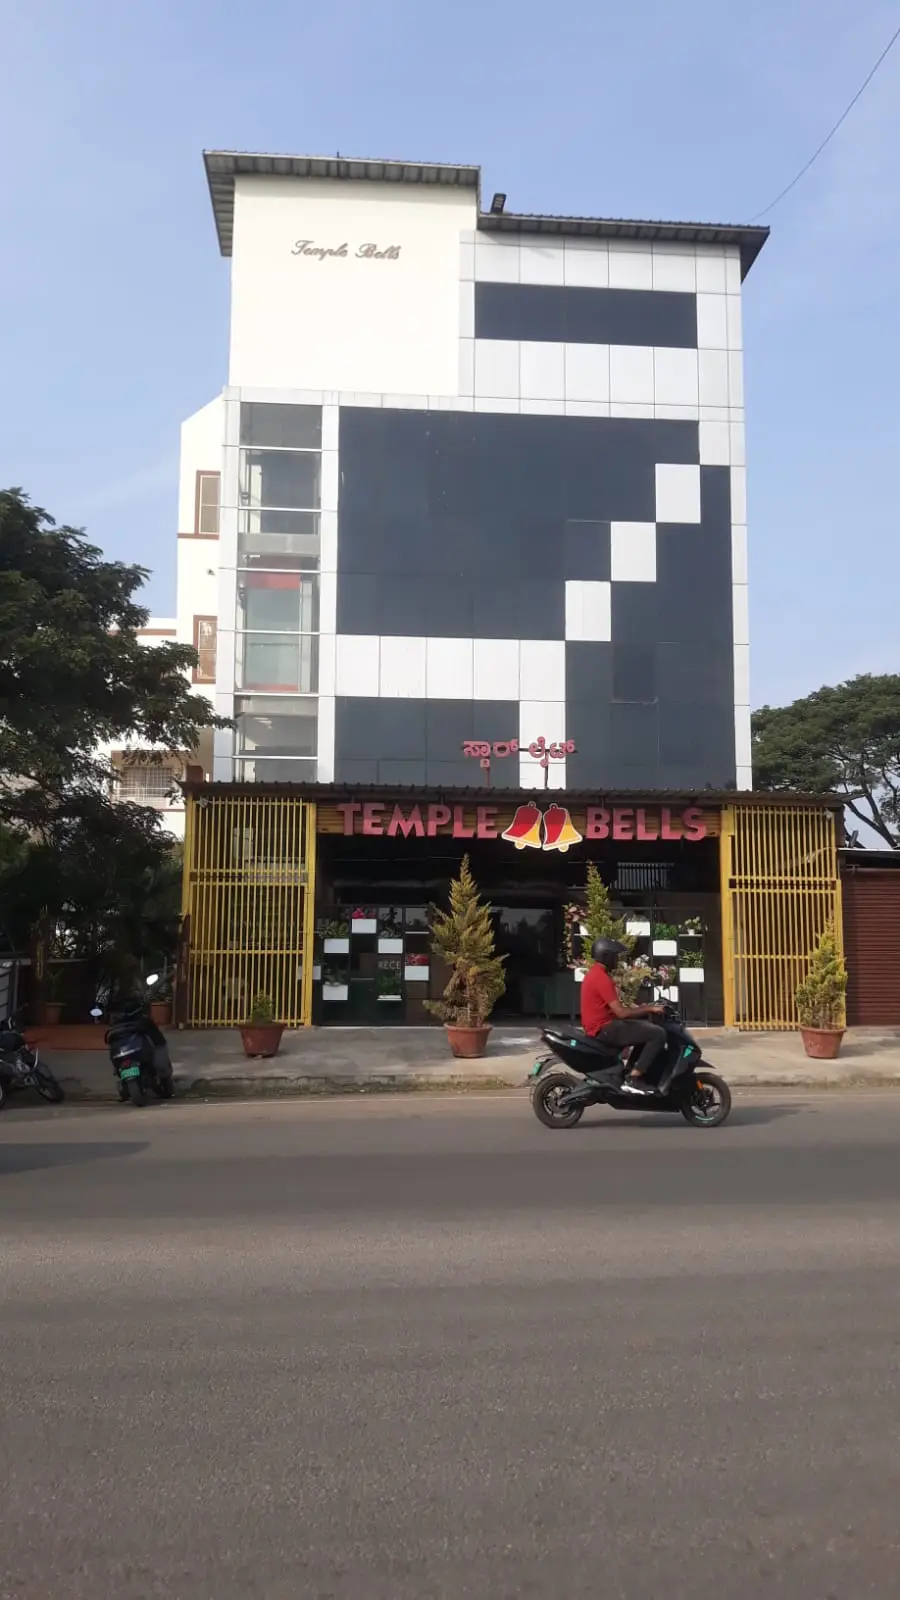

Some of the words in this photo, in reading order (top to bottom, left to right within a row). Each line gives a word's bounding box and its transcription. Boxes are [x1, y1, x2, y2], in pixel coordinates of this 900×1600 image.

[291, 239, 349, 261] Temple
[355, 242, 402, 260] Bells
[336, 801, 500, 840] TEMPLE
[585, 806, 708, 842] BELLS
